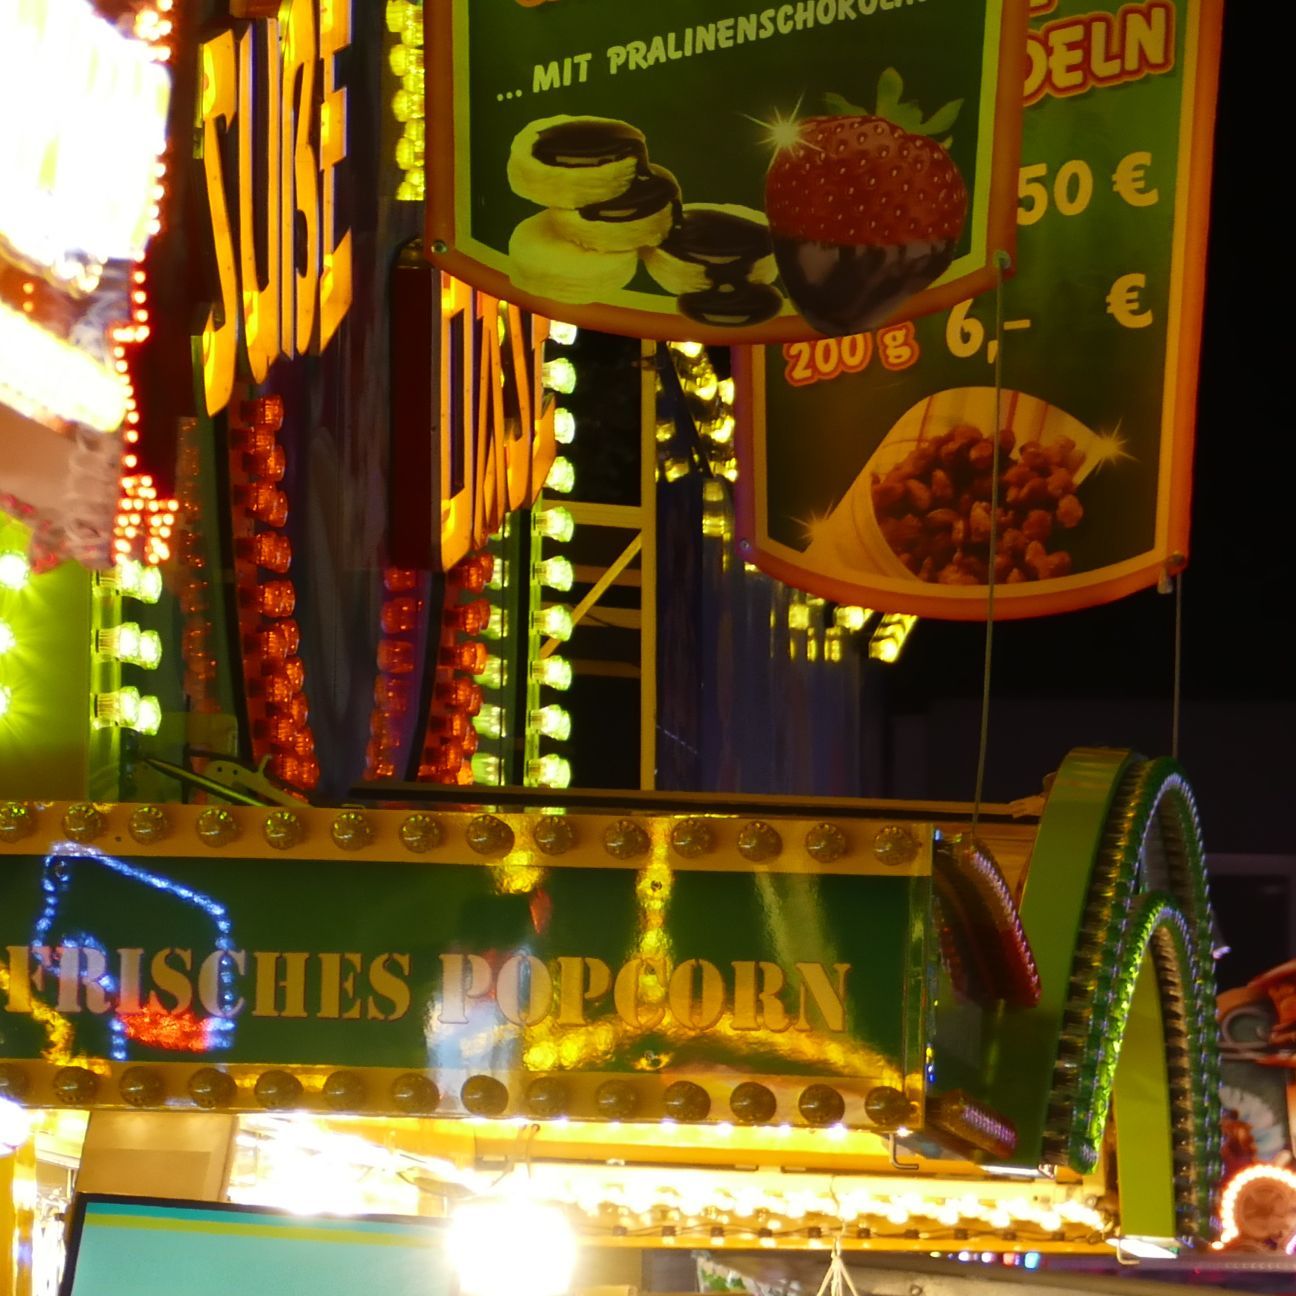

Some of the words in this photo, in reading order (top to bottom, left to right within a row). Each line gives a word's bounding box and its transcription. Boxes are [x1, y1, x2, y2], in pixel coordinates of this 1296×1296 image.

[532, 52, 592, 93] MIT
[784, 331, 870, 384] 200
[882, 323, 916, 369] g
[4, 945, 413, 1021] FRISCHES
[438, 952, 852, 1033] POPCORN
